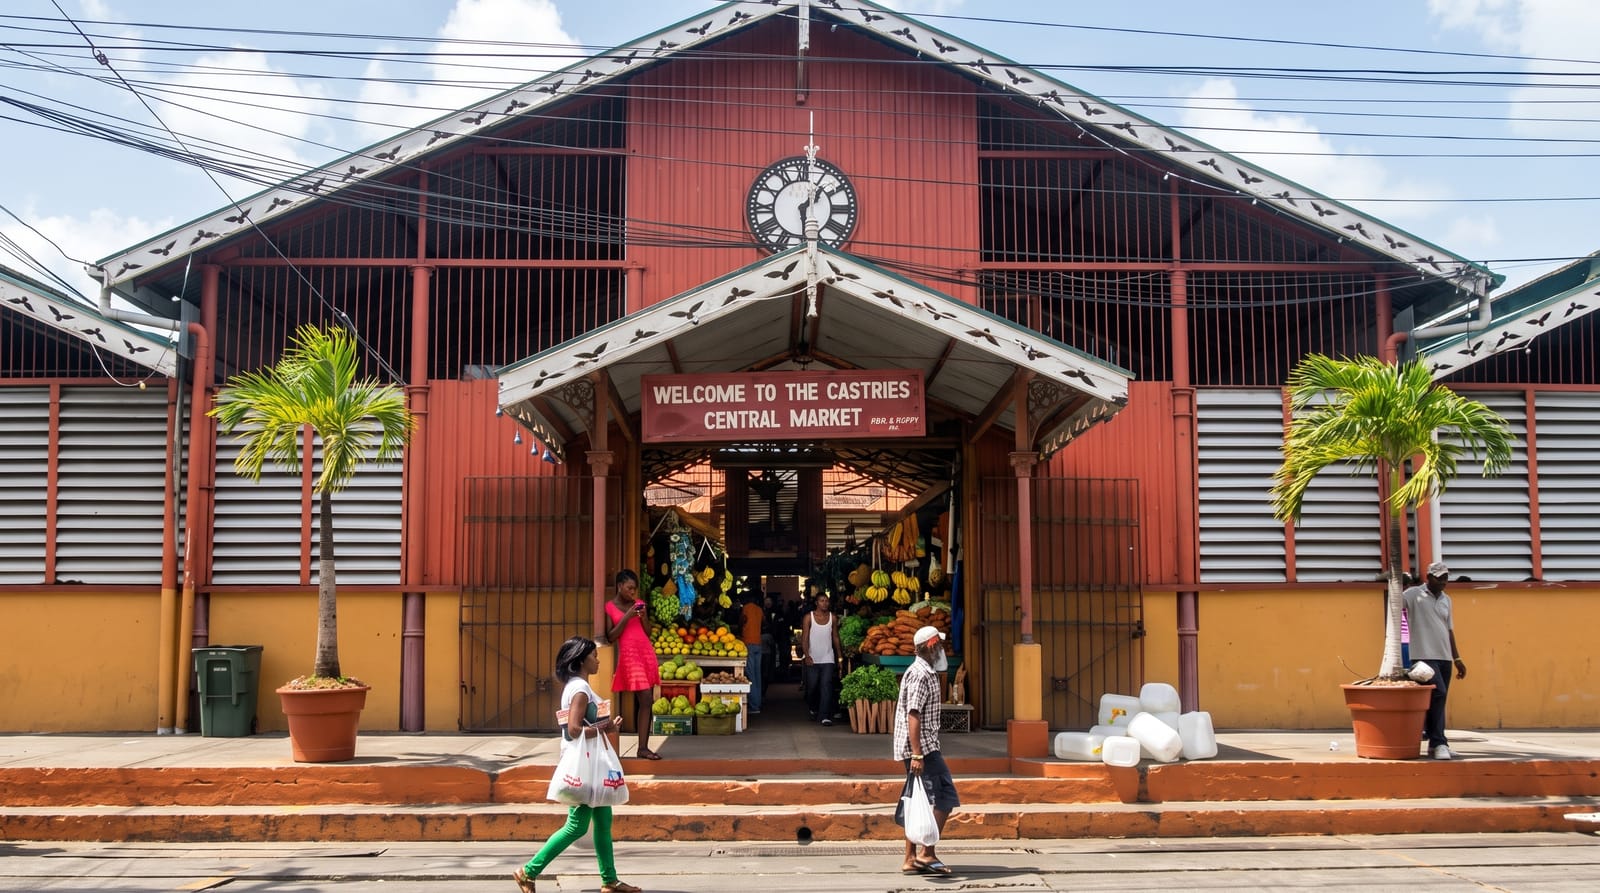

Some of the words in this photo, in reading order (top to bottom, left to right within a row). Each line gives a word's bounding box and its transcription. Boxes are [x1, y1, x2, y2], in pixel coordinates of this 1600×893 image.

[653, 385, 746, 404] WELCOME
[753, 383, 777, 401] TO
[784, 382, 819, 401] THE
[826, 381, 910, 400] CASTRIES
[704, 410, 781, 430] CENTRAL
[789, 408, 863, 428] MARKET
